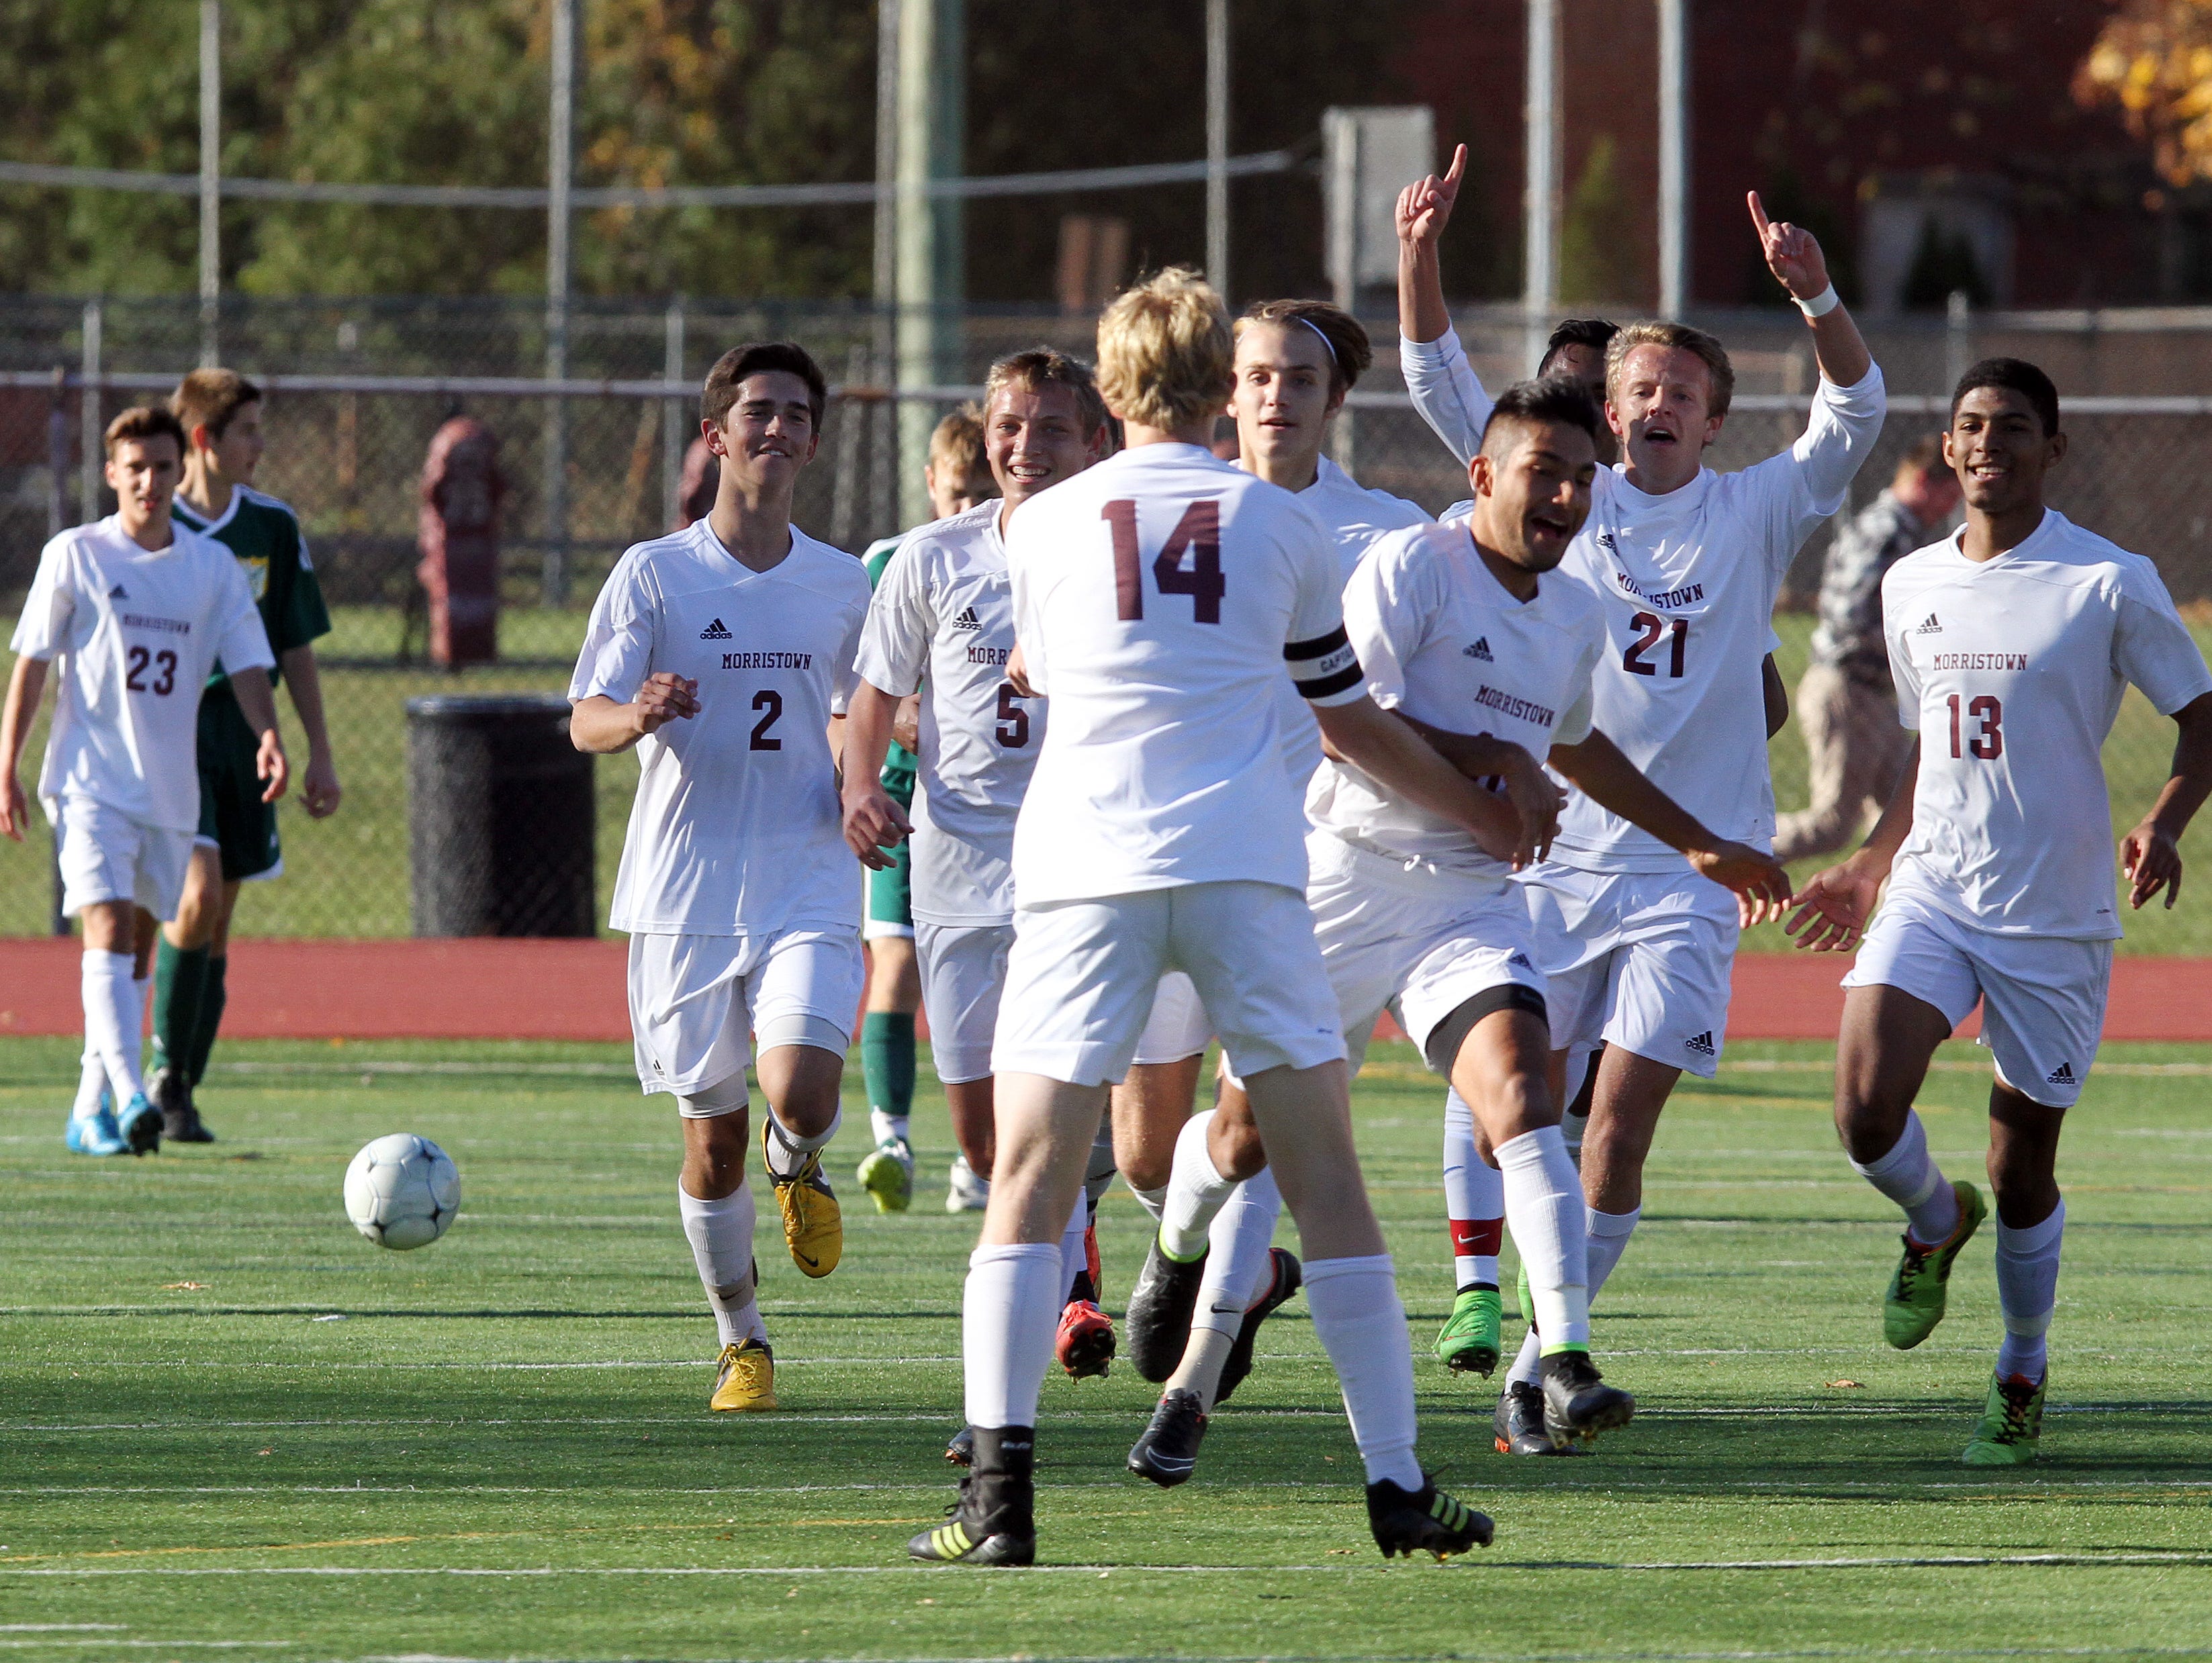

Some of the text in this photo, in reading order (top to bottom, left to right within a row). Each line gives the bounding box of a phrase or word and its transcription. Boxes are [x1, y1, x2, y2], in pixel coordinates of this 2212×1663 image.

[1101, 500, 1226, 624] 14
[700, 631, 733, 639] adidas
[721, 652, 812, 670] MORRISTOWN
[1623, 612, 1689, 677] 21
[1934, 653, 2028, 671] MORRISTOWN
[126, 645, 177, 696] 23
[749, 690, 783, 751] 2
[996, 684, 1030, 749] 5
[1474, 684, 1555, 727] MORRISTOWN
[1947, 694, 2002, 760] 13
